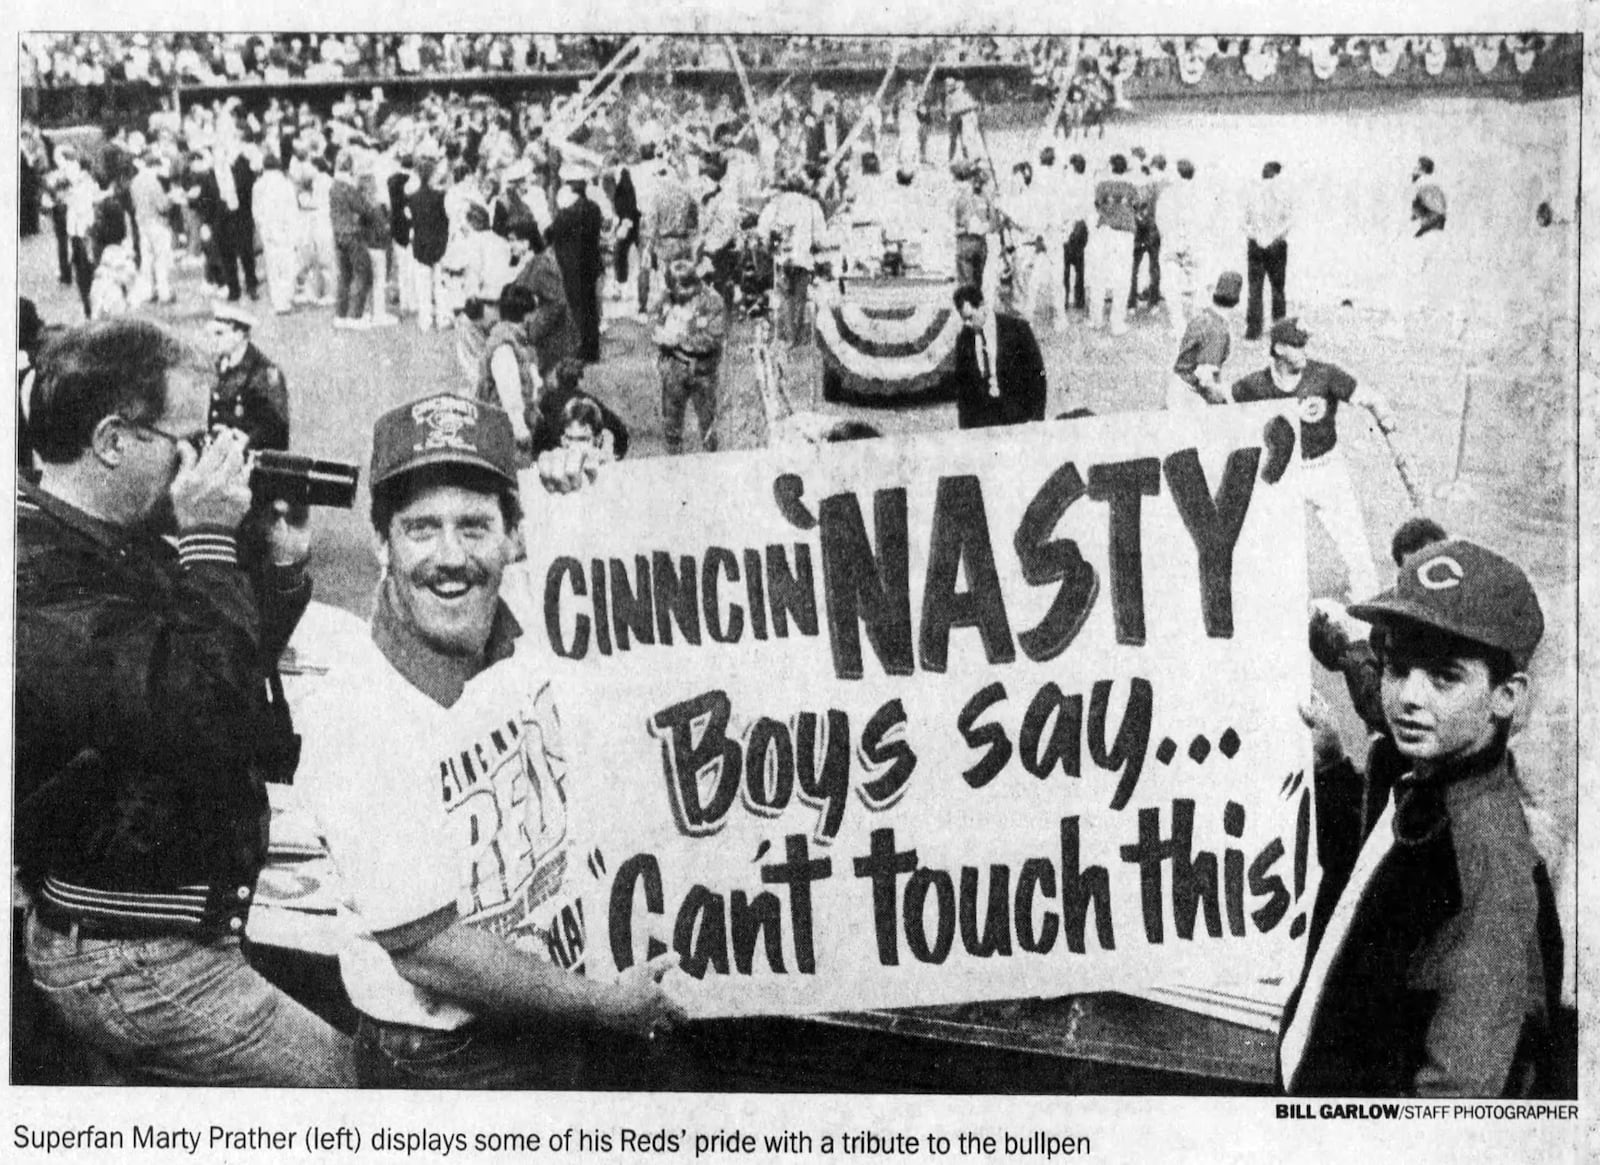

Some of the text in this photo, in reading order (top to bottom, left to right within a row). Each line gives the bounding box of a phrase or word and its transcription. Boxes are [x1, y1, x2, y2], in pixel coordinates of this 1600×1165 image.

[646, 676, 1242, 846] Boys say...
[587, 833, 833, 984] "Can't
[853, 815, 1116, 967] touch
